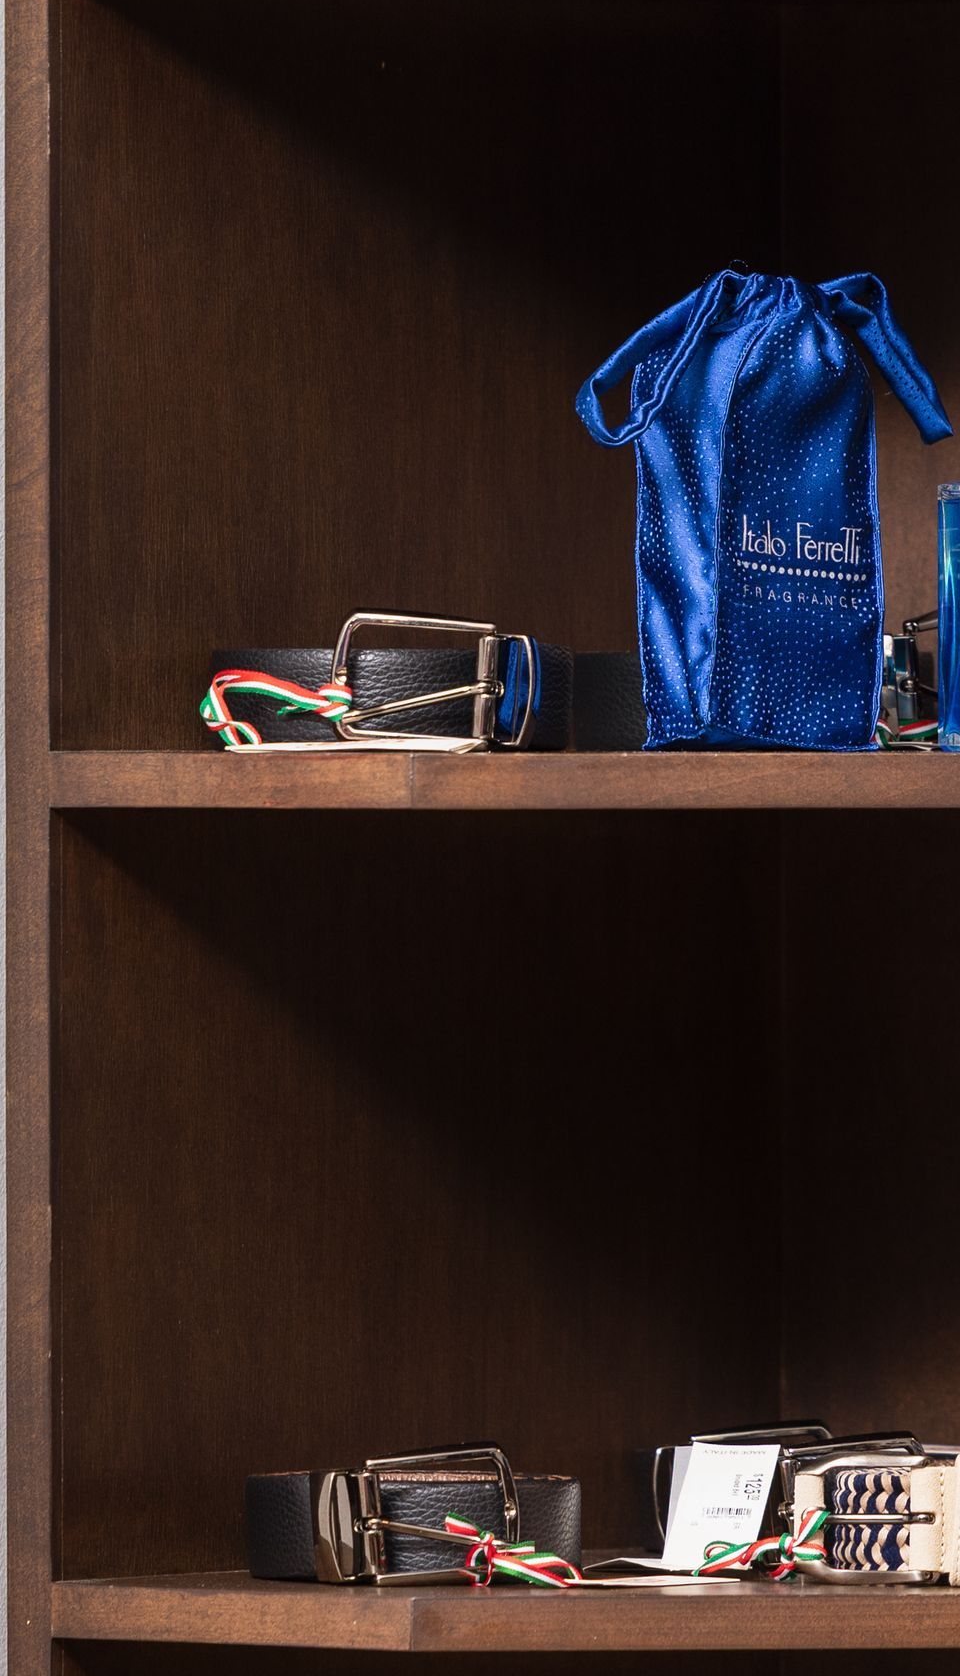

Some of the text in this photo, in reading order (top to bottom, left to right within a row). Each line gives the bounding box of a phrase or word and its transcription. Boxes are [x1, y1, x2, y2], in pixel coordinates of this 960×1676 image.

[742, 513, 862, 565] Italo Ferretti
[743, 584, 858, 609] FRAGRANCE
